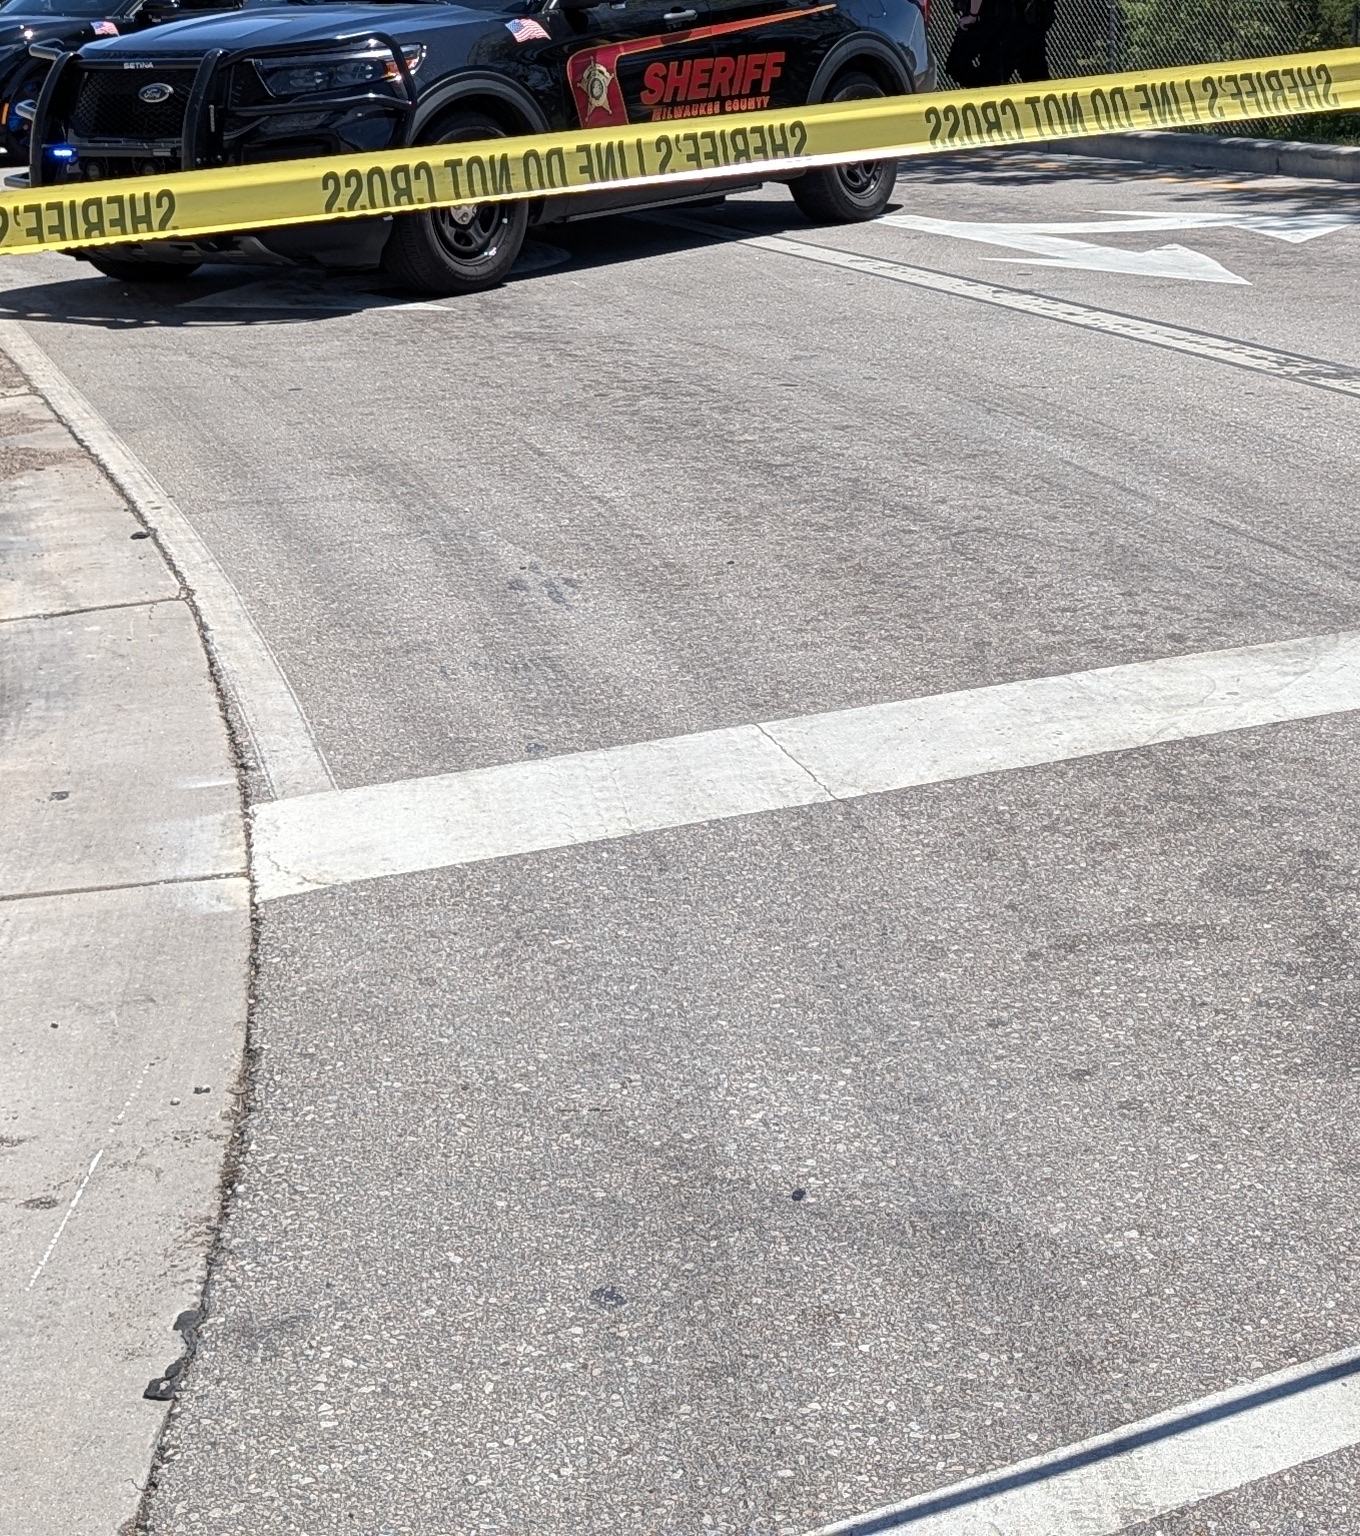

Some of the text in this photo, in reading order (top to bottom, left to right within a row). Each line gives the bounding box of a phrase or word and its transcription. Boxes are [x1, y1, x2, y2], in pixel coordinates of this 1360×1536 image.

[640, 52, 786, 105] SHERIFF
[652, 96, 770, 121] MILWAUKEE COUNTY
